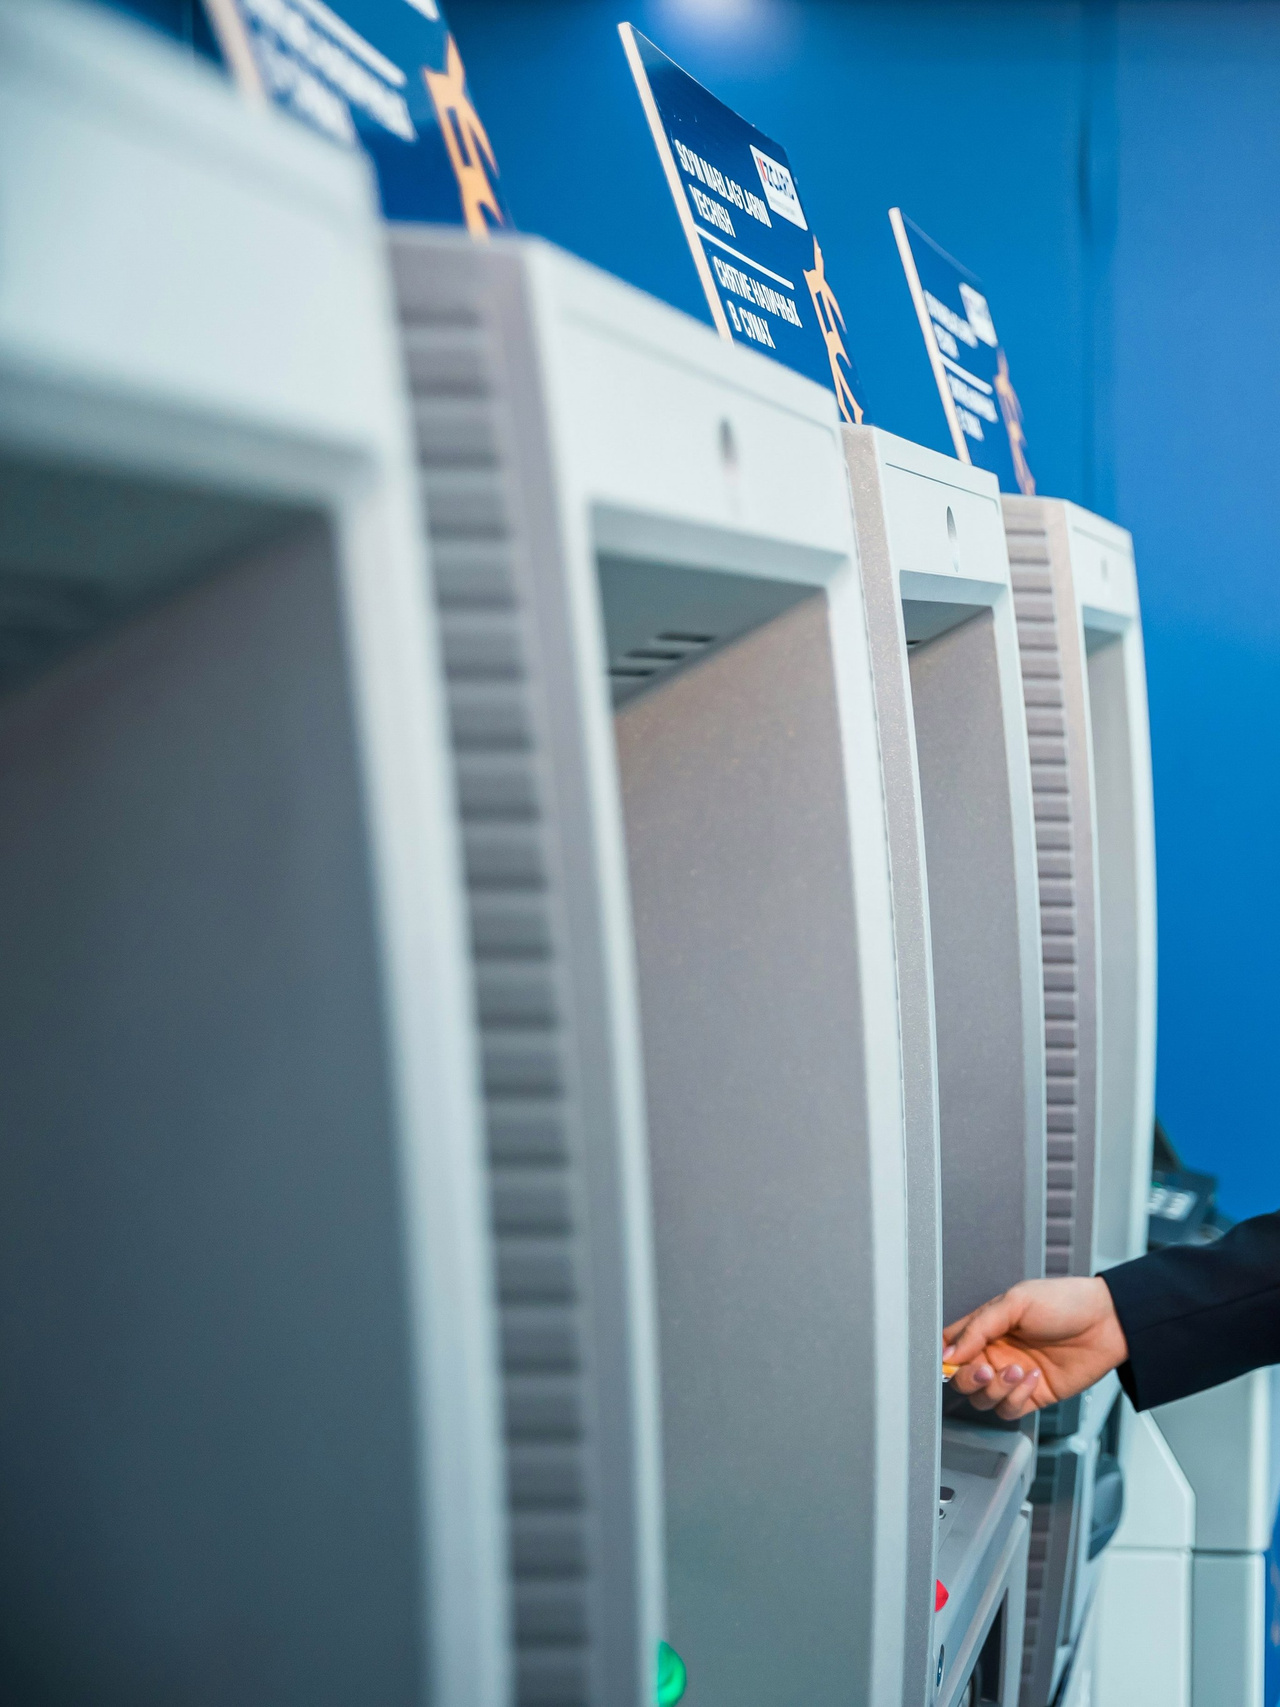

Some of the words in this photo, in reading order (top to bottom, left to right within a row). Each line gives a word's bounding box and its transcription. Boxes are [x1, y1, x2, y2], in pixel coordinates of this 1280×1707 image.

[688, 183, 736, 238] YECHISH
[713, 255, 757, 304] СНЯТИЕ
[749, 277, 803, 328] НАЛИЧНЫХ
[738, 307, 776, 349] СУМАХ
